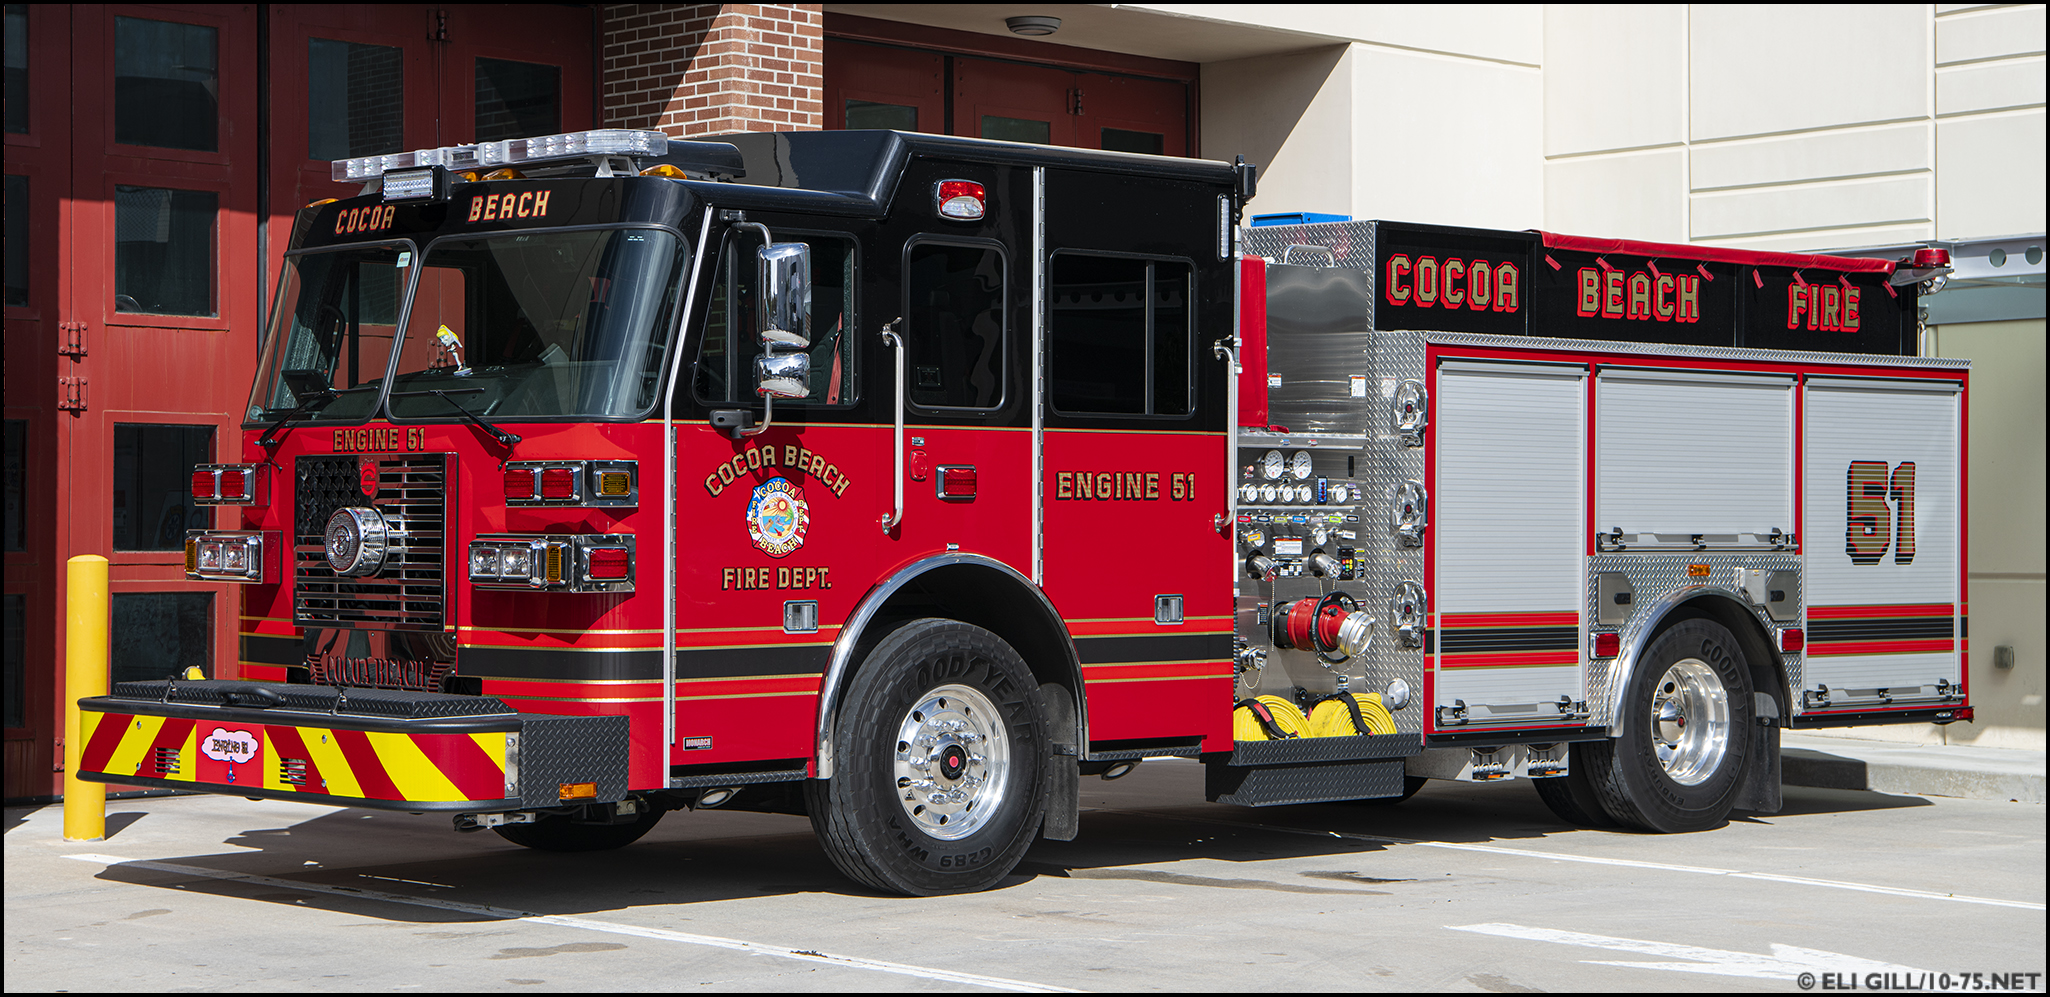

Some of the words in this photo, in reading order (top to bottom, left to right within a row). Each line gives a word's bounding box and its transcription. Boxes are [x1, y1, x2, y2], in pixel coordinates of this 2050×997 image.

[335, 204, 396, 235] COCOA
[467, 190, 551, 223] BEACH
[1386, 253, 1519, 313] COCOA
[1577, 266, 1700, 323] BEACH
[1787, 282, 1861, 333] FIRE
[333, 428, 399, 452] ENGINE
[406, 427, 425, 451] 51
[704, 445, 777, 498] COCOA
[783, 444, 851, 499] BEACH
[1055, 470, 1160, 501] ENGINE
[1170, 472, 1196, 502] 51
[759, 480, 796, 499] COCOA
[751, 500, 759, 534] FIRE
[797, 499, 805, 534] DEPT
[1845, 460, 1916, 566] 51
[758, 537, 798, 555] BEACH
[721, 566, 770, 591] FIRE
[776, 566, 832, 590] DEPT.
[326, 656, 371, 685] COCOA
[374, 658, 426, 688] BEACH
[900, 655, 1034, 747] GOODYEAR
